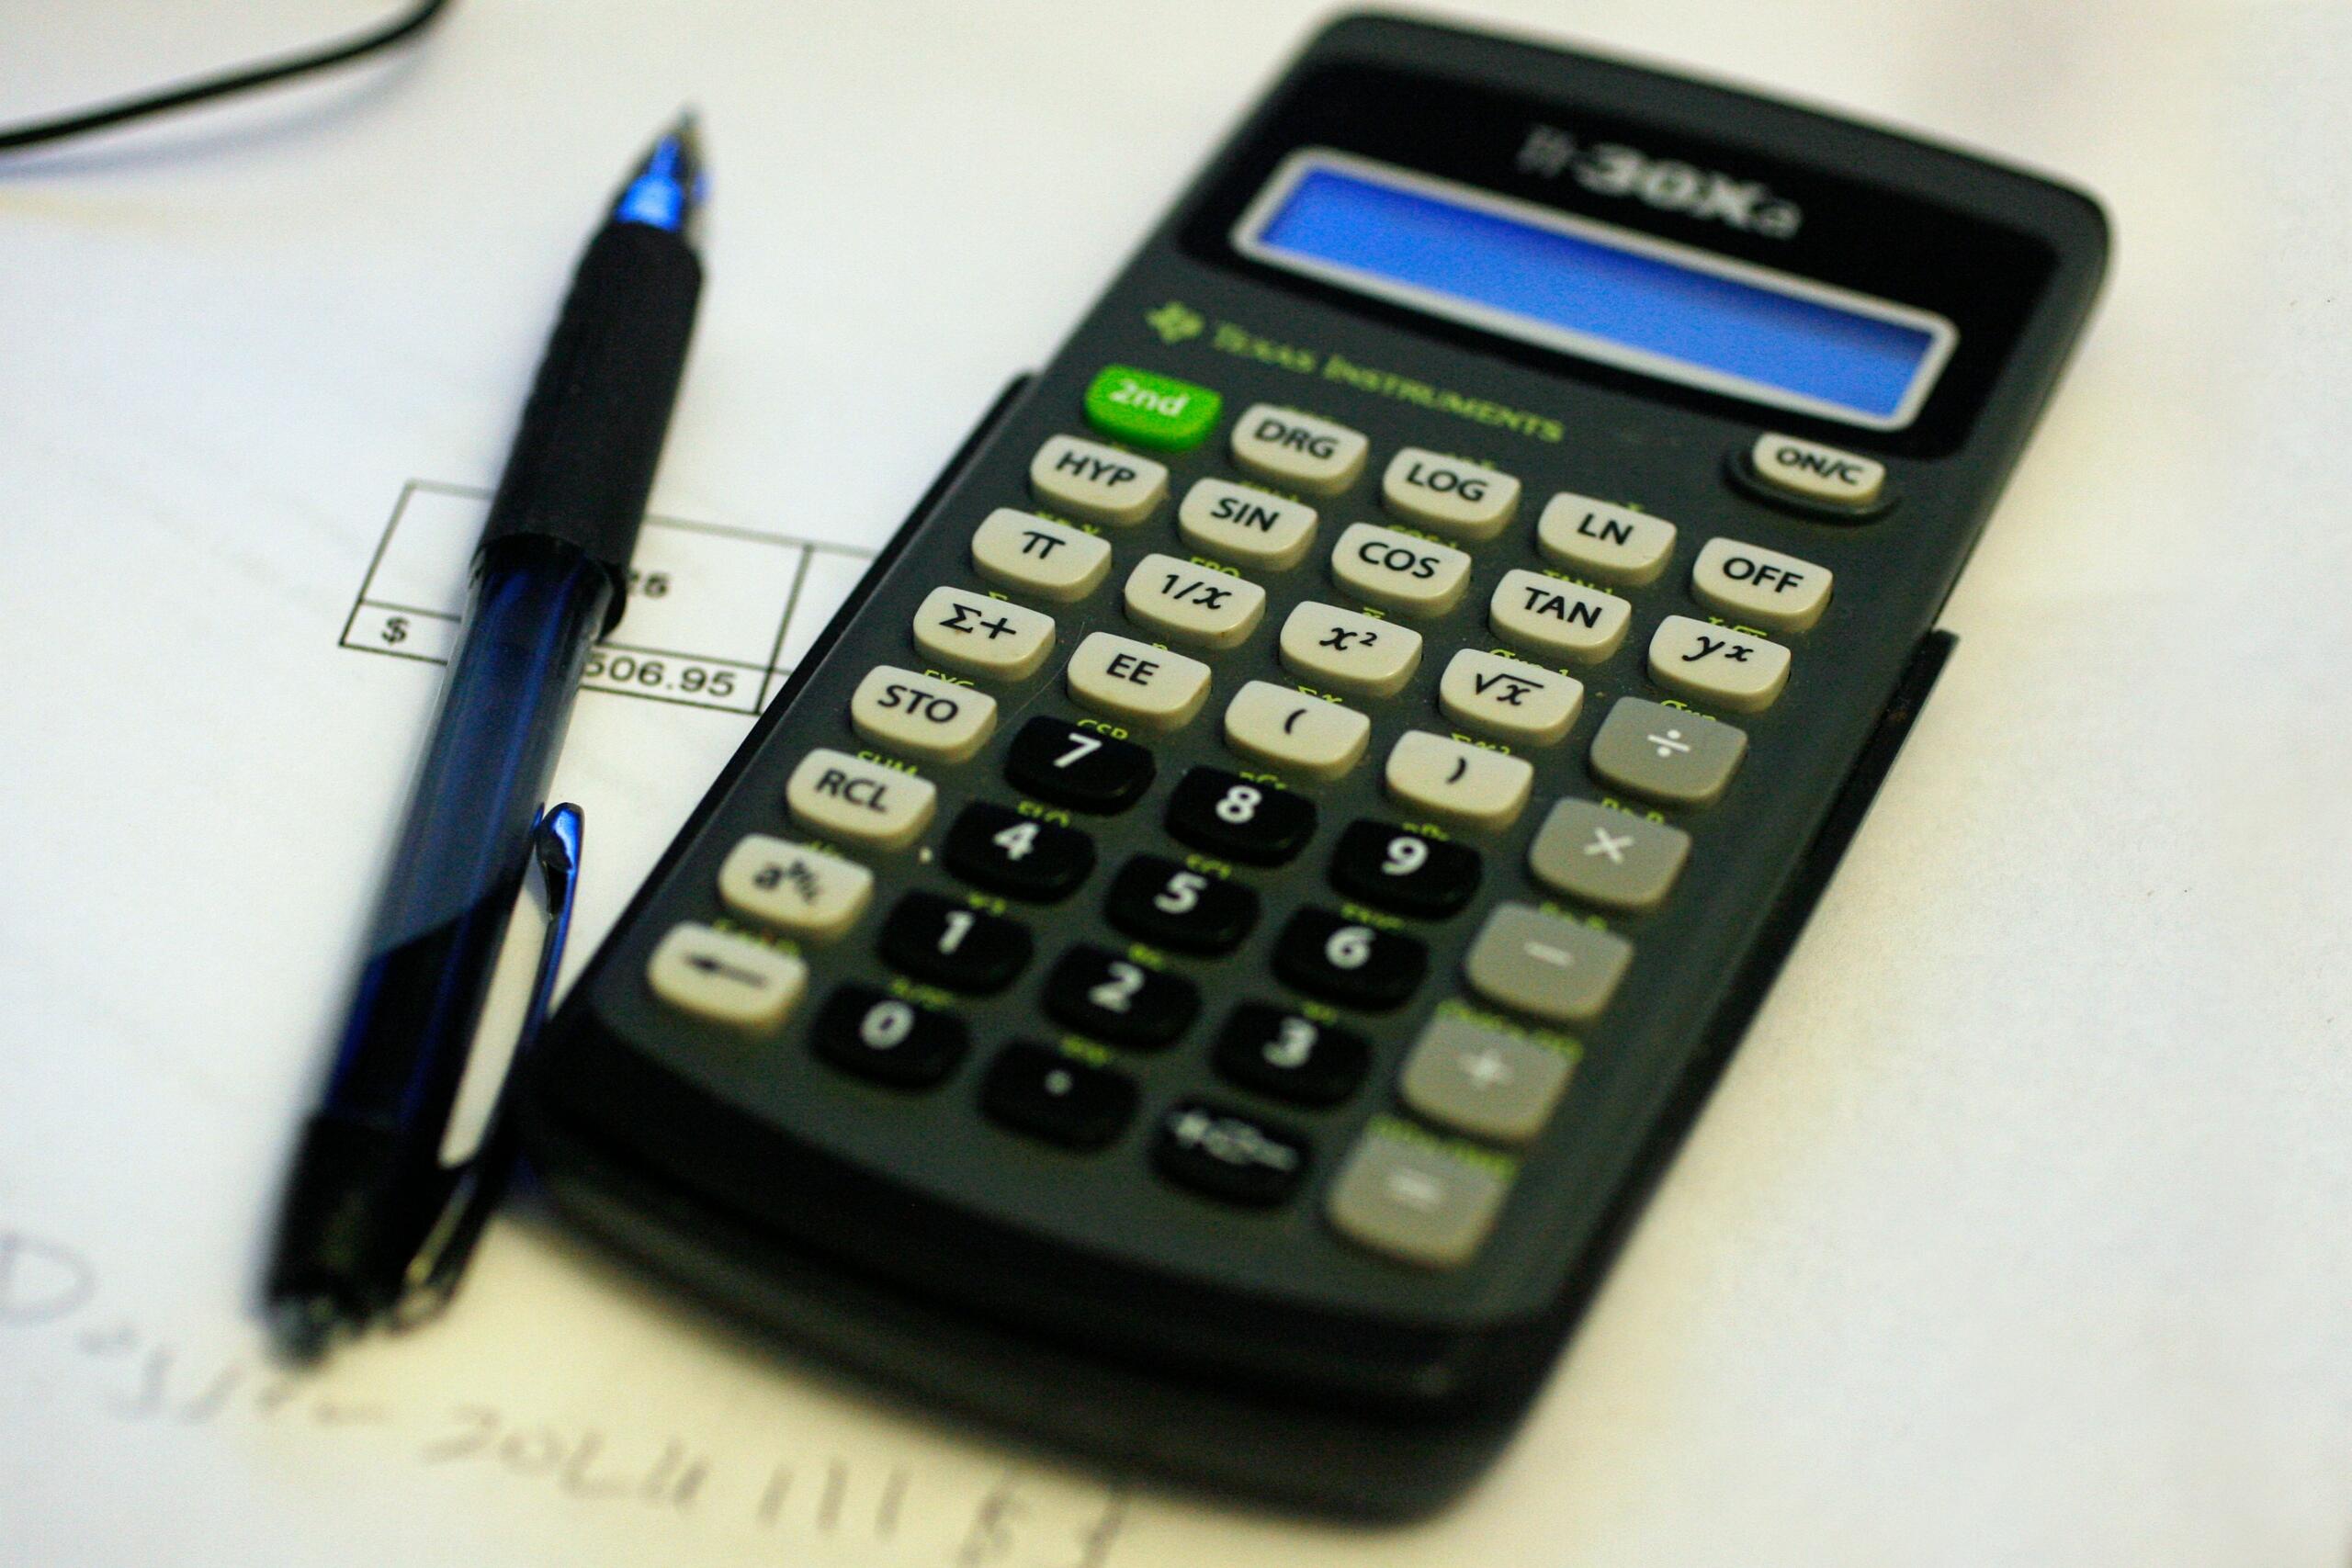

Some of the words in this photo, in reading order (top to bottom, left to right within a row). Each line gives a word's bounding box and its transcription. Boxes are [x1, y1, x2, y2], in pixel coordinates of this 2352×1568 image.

[1109, 380, 1190, 417] 2nd
[1213, 321, 1317, 373] TEXAS
[1323, 355, 1565, 443] INSTRUMENTS
[1254, 419, 1339, 459] DRG
[1056, 451, 1137, 488] HYP
[1406, 462, 1488, 502] LOG
[1775, 446, 1865, 486] ON/C
[1211, 497, 1281, 533] SIN
[1577, 513, 1634, 546] LN
[1359, 541, 1441, 579] COS
[1723, 556, 1805, 594] OFF
[1524, 586, 1603, 628] TAN
[380, 616, 410, 645] $
[583, 652, 736, 697] 506.95
[1106, 653, 1159, 687] EE
[877, 684, 958, 723] STO
[1054, 732, 1102, 768] 7
[814, 767, 888, 814] RCL
[1216, 785, 1263, 825] 8
[993, 823, 1041, 861] 4
[1382, 836, 1429, 875] 9
[1154, 872, 1208, 913] 5
[938, 910, 975, 955] 1
[1325, 926, 1375, 969] 6
[1088, 962, 1146, 1013] 2
[859, 999, 914, 1050] 0
[1263, 1017, 1318, 1069] 3
